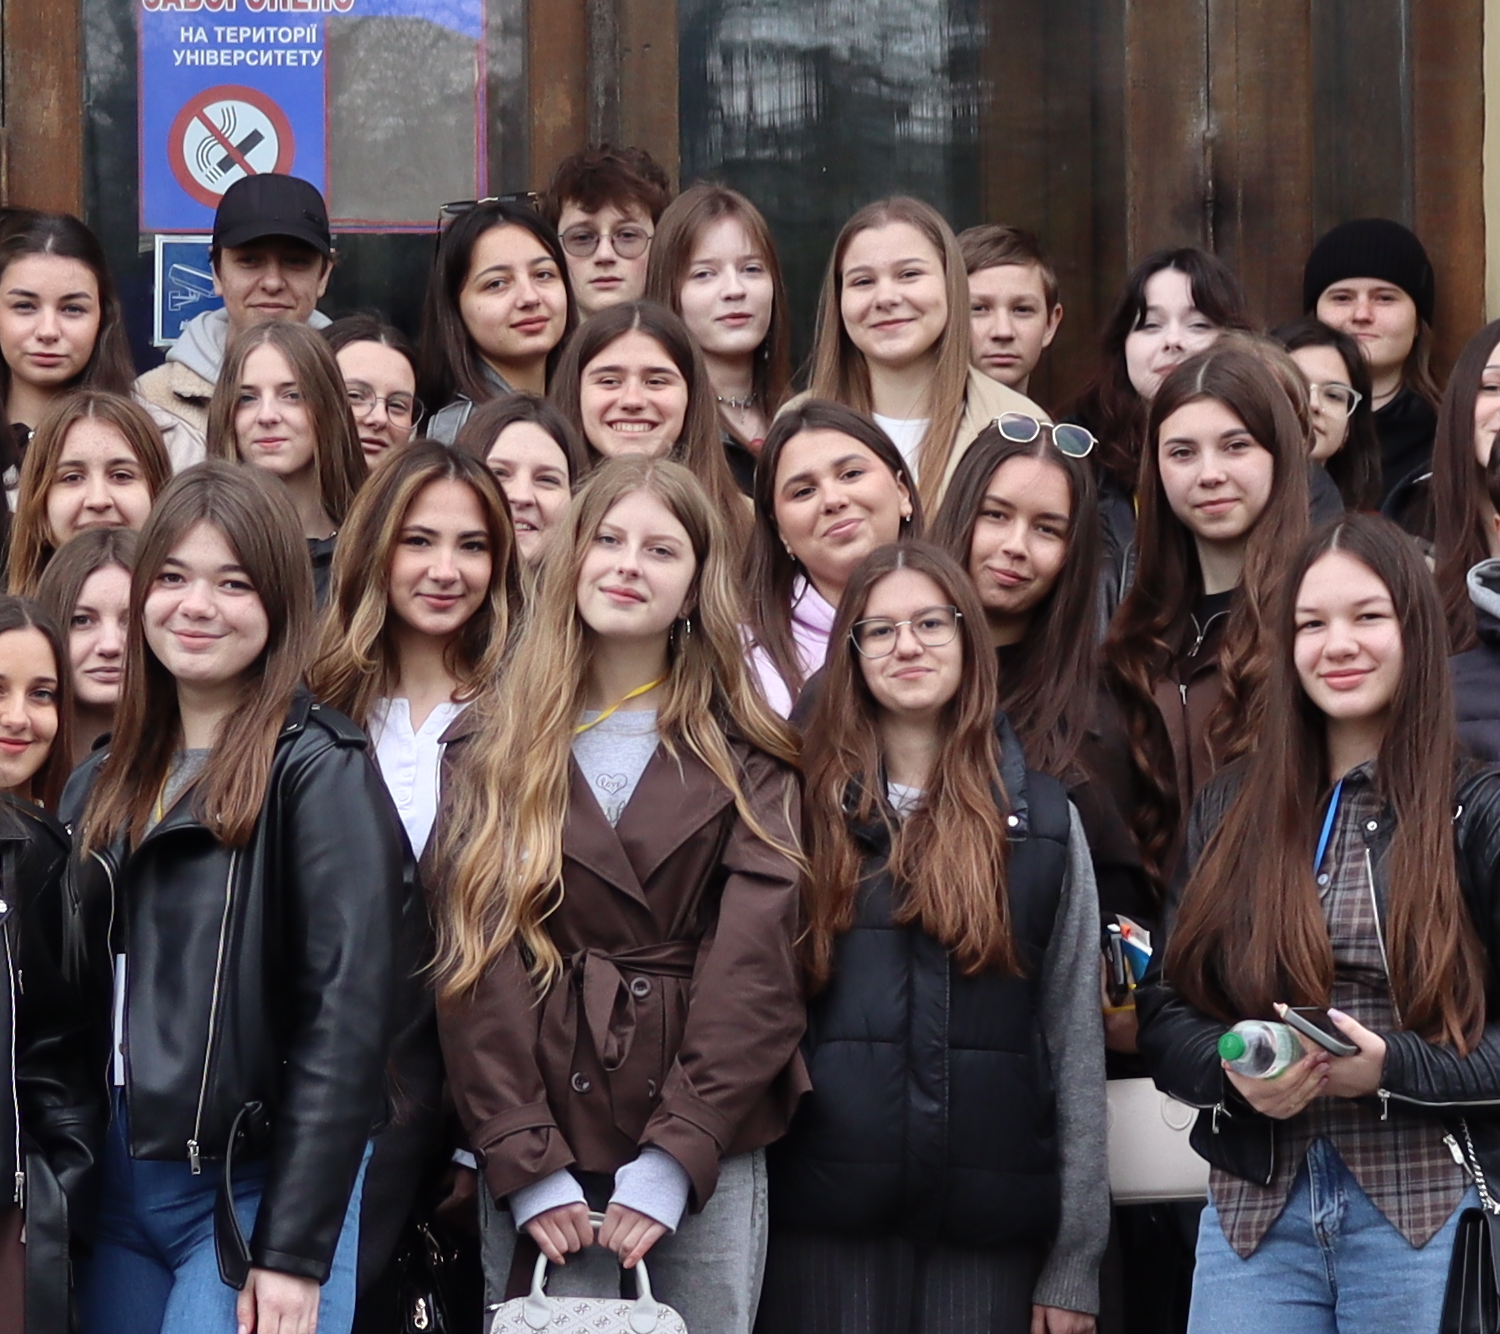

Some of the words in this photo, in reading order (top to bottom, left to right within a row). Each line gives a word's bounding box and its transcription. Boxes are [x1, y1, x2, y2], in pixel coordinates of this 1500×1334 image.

[180, 26, 208, 43] НА
[214, 23, 318, 43] ТЕРИТОРІЇ
[172, 49, 323, 67] УНІВЕРСИТЕТУ
